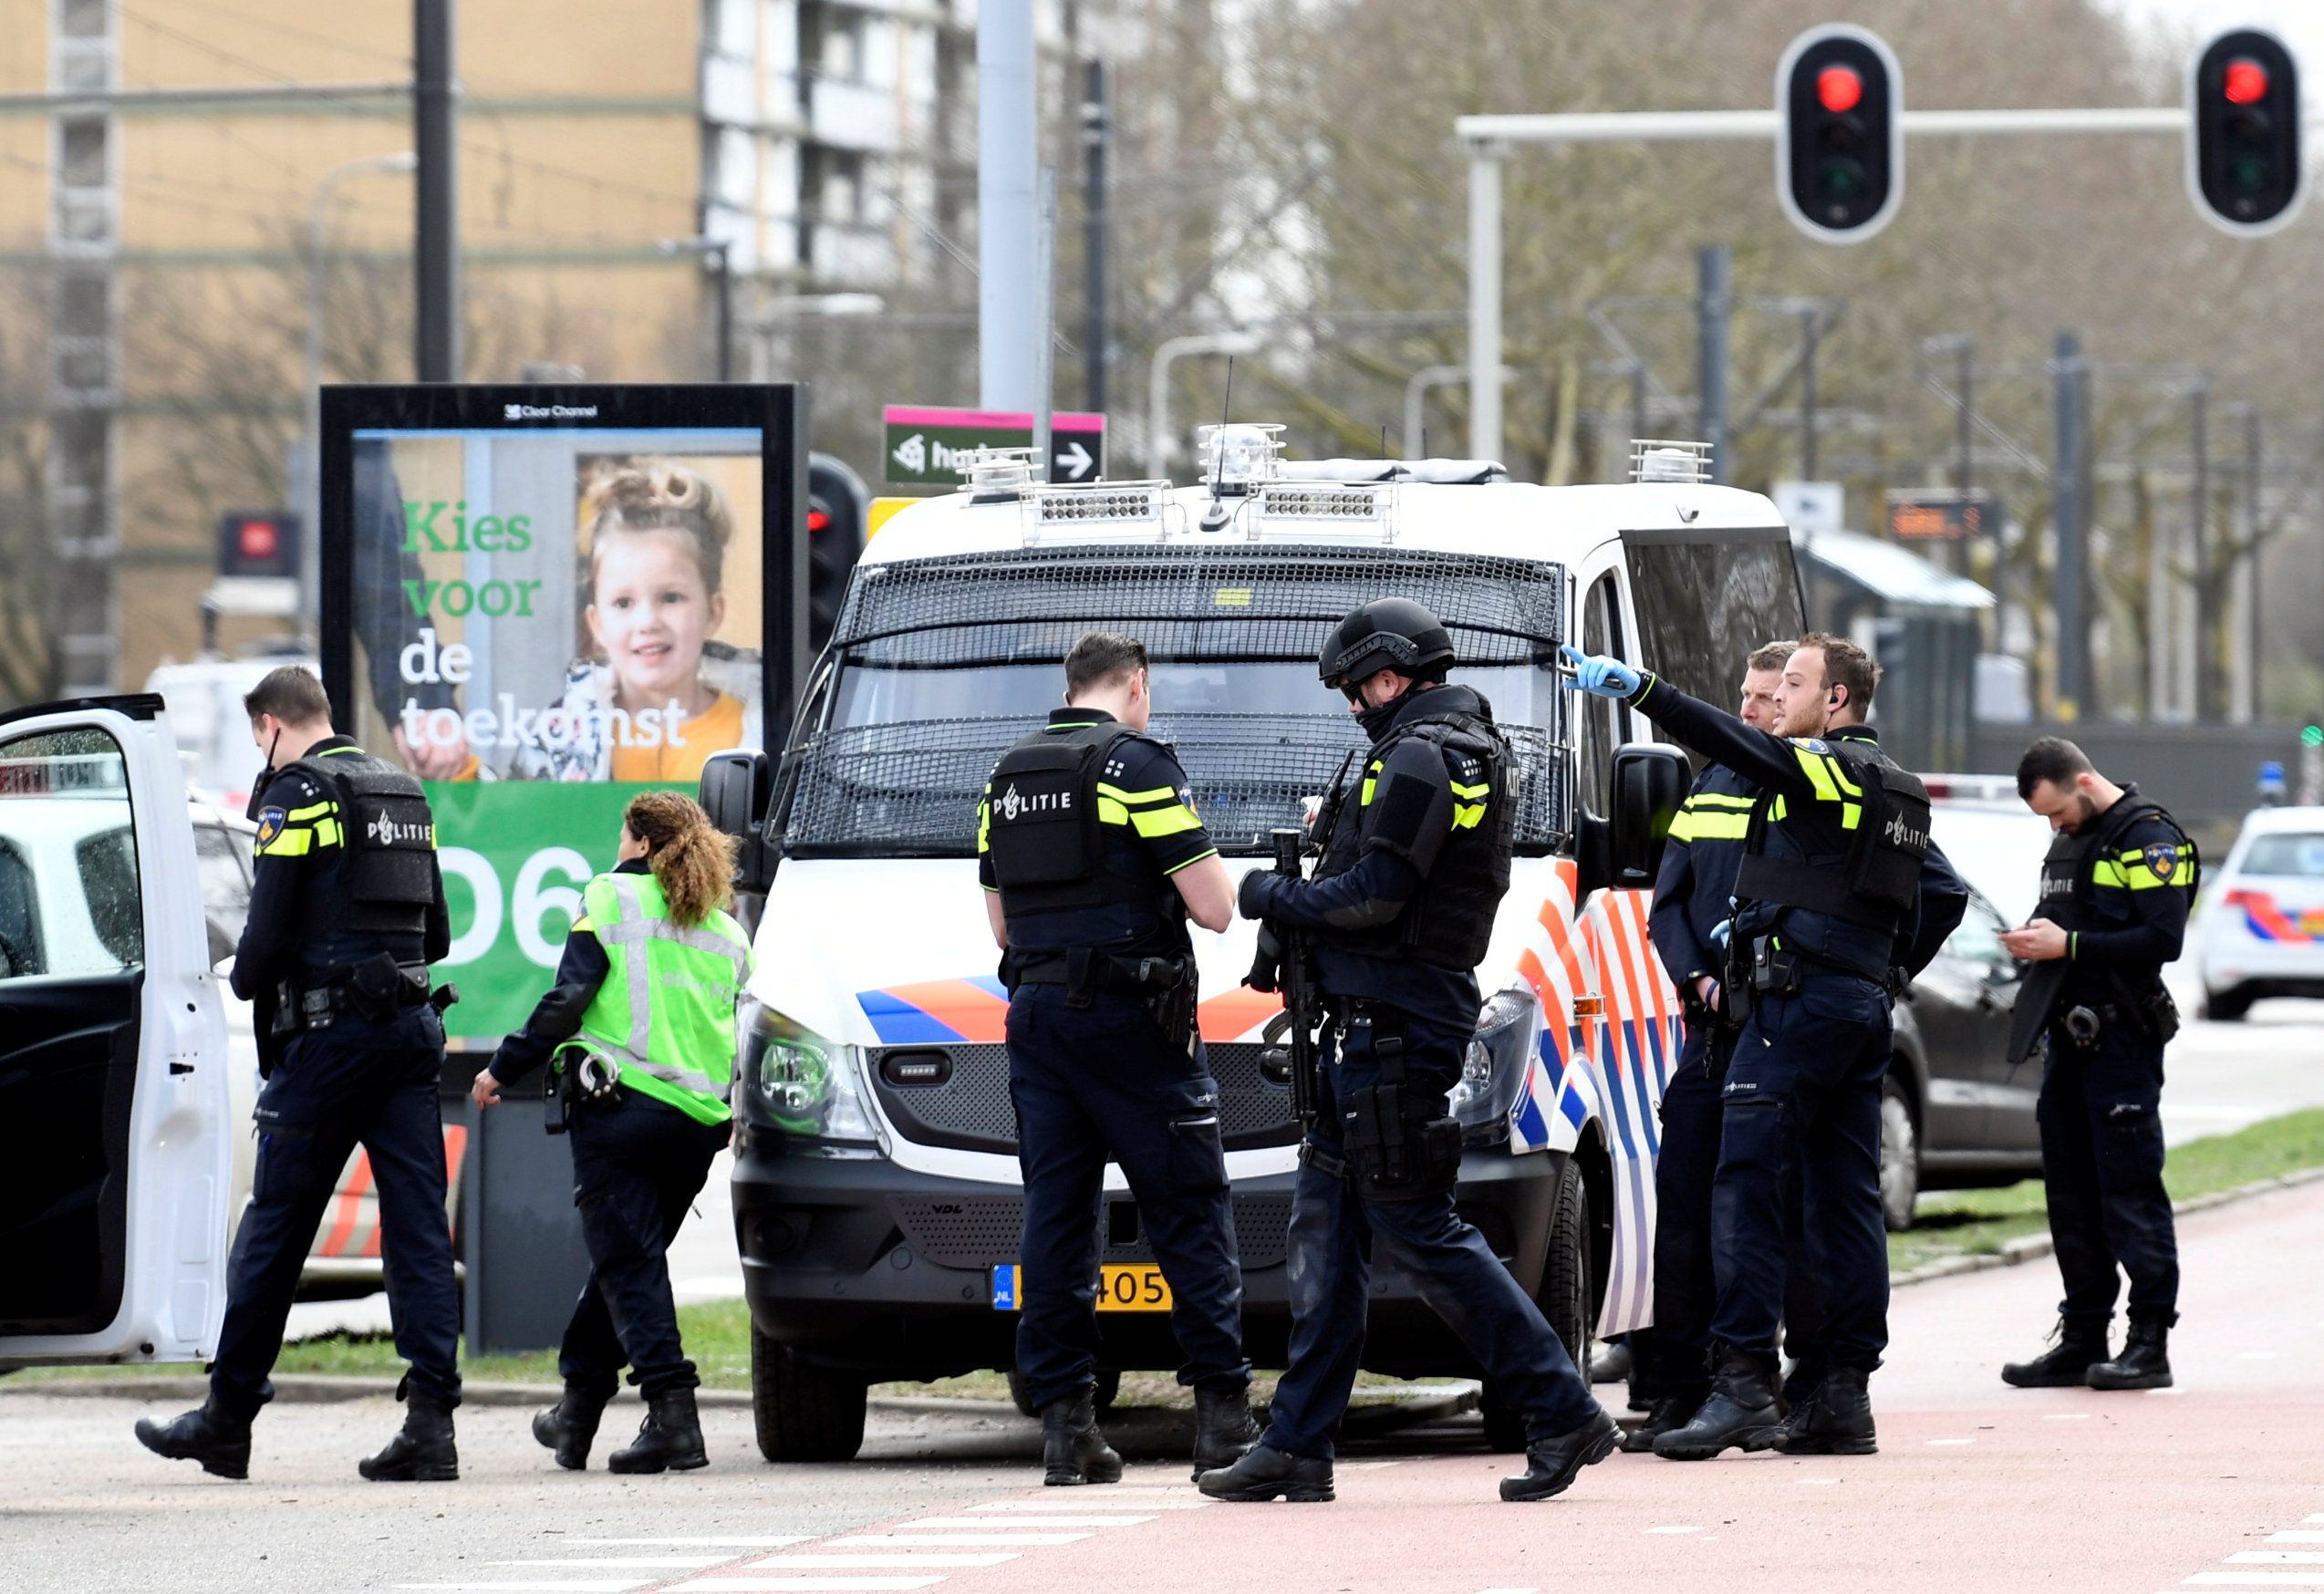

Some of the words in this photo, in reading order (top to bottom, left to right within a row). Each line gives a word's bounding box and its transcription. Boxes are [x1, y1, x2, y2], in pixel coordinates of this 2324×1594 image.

[522, 404, 550, 418] Clear
[552, 404, 597, 418] Channel
[402, 501, 533, 553] Kies
[401, 578, 542, 617] voor
[399, 628, 473, 684] de
[400, 692, 687, 748] toekomst
[993, 784, 1071, 819] POLITIE
[368, 810, 431, 845] POLITIE
[1884, 811, 1929, 849] POLITIE
[2041, 870, 2072, 897] OLITIE
[438, 846, 621, 968] D6
[932, 1205, 963, 1214] VDL
[997, 1291, 1012, 1301] NL
